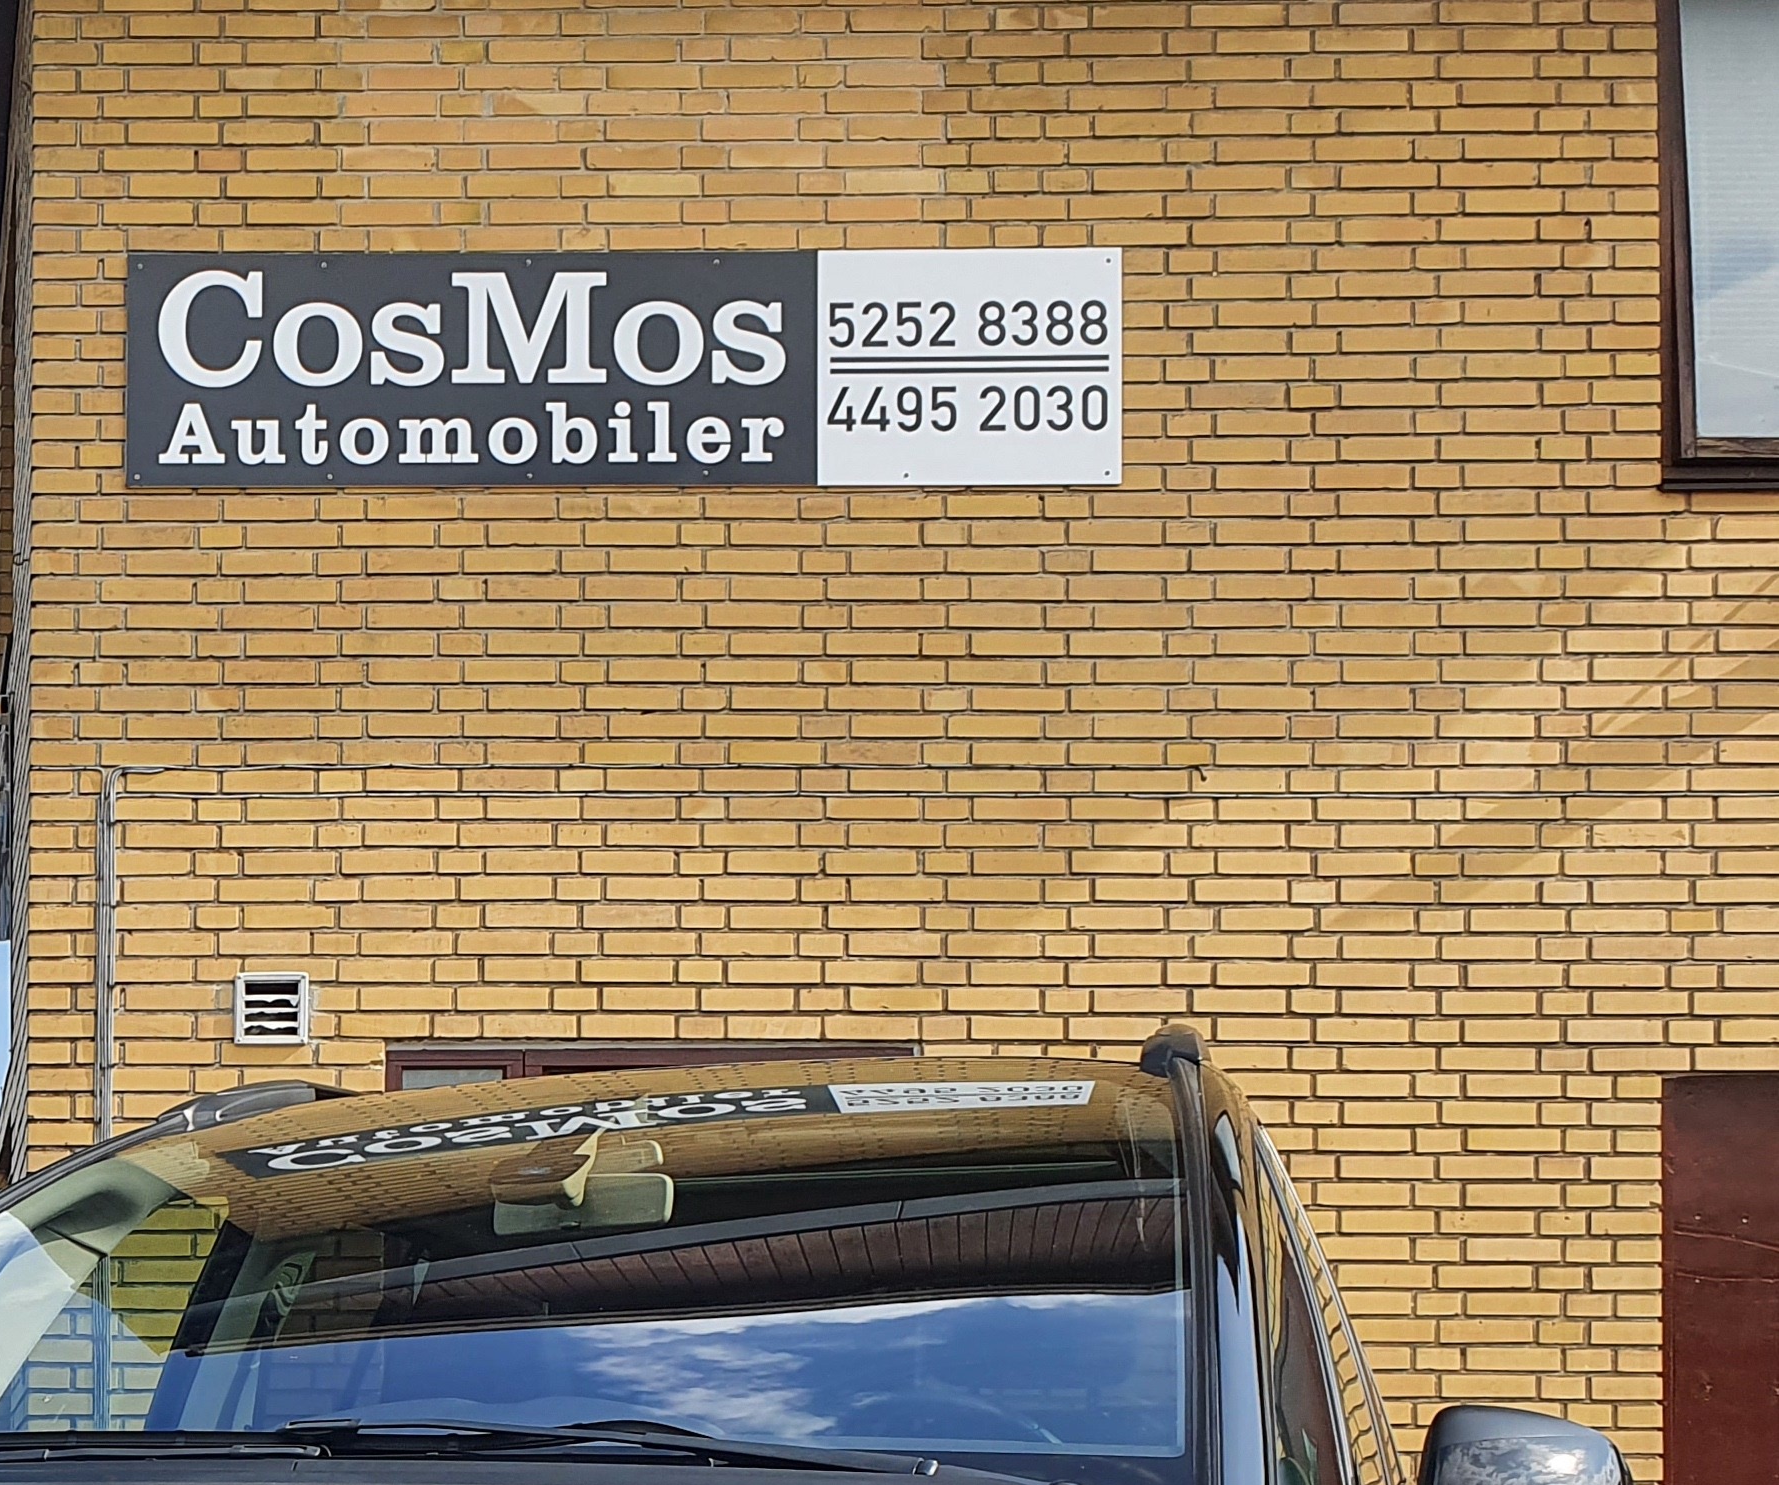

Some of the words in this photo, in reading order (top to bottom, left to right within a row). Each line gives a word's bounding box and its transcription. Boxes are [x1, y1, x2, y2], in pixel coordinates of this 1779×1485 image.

[158, 270, 786, 388] CosMos
[829, 301, 956, 348] 5252
[978, 300, 1108, 346] 8388
[158, 401, 785, 465] Automobiler
[827, 386, 957, 432] 4495
[979, 385, 1108, 432] 2030
